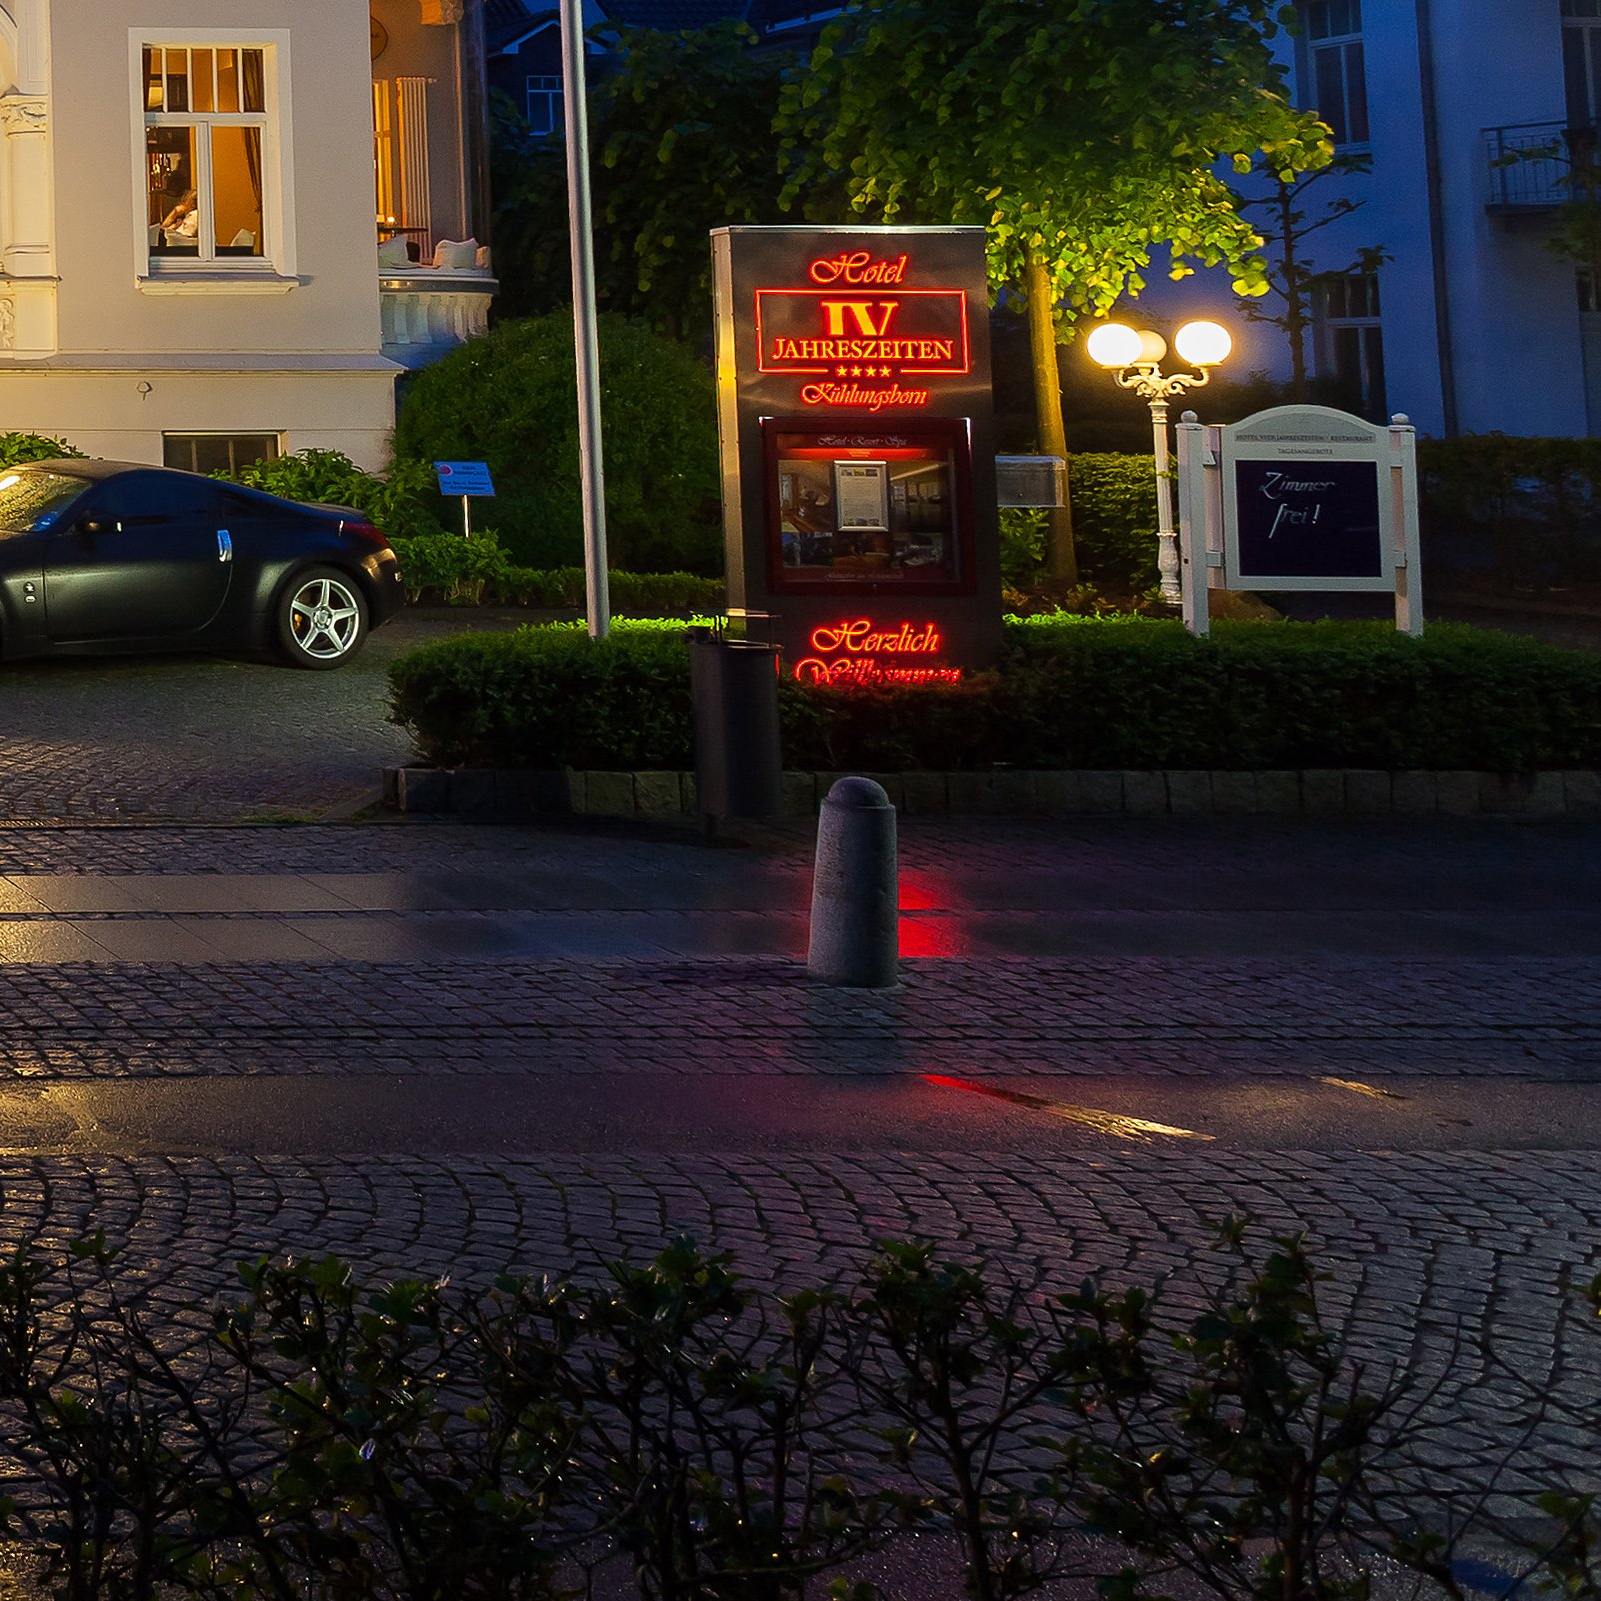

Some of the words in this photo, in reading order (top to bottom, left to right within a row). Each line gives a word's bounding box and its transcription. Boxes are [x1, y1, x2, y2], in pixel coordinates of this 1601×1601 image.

[811, 252, 909, 284] Hotel
[821, 301, 899, 336] IV
[772, 338, 954, 360] JAHRESZEITEN
[802, 383, 928, 411] Kühlungsborn
[1260, 471, 1336, 499] Zimmer
[812, 620, 940, 651] Herzlich
